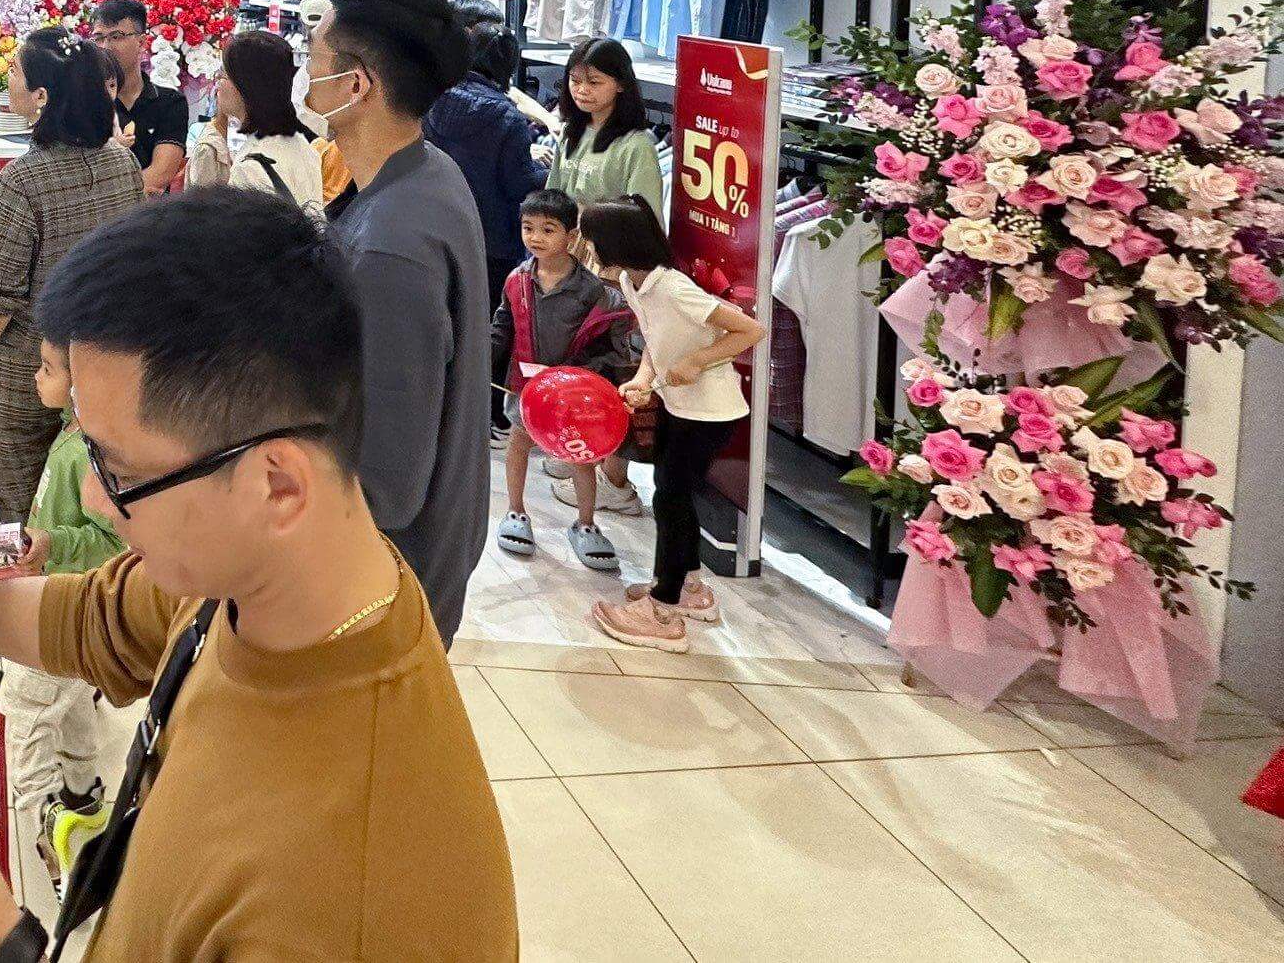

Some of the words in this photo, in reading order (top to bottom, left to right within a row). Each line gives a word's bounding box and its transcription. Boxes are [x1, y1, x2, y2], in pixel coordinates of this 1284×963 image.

[696, 115, 719, 134] SALE
[680, 128, 749, 219] 50%
[688, 209, 704, 225] MUA
[710, 217, 730, 235] TẶNG
